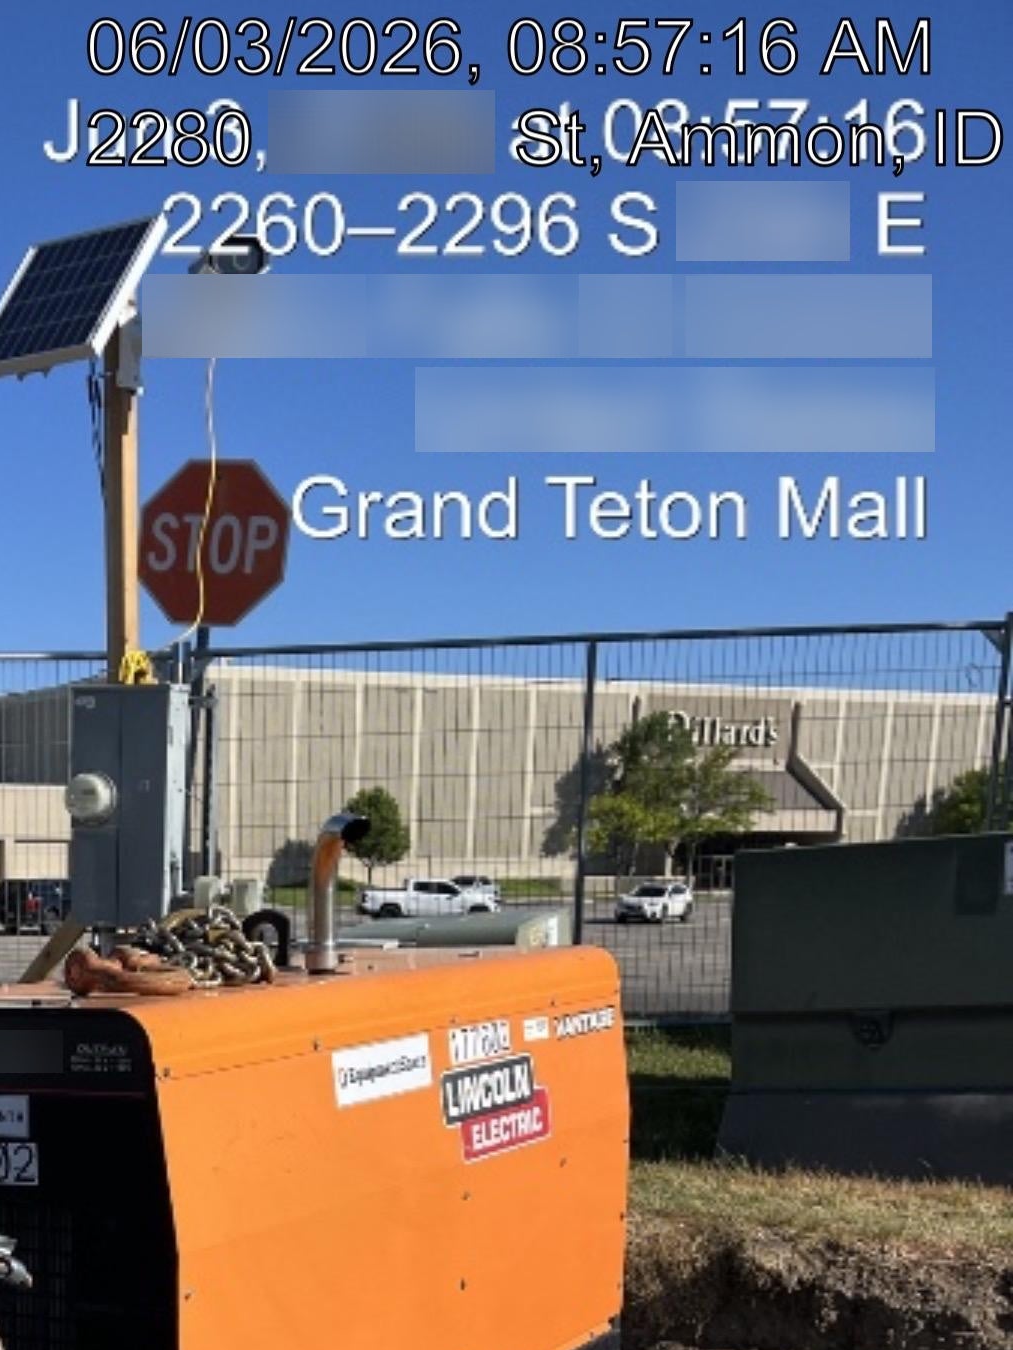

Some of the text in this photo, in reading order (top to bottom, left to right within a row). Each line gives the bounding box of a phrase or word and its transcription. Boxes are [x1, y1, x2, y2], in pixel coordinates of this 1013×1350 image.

[147, 512, 279, 575] STOP
[445, 1064, 531, 1118] LINCOLN
[470, 1105, 544, 1150] ELECTRIC
